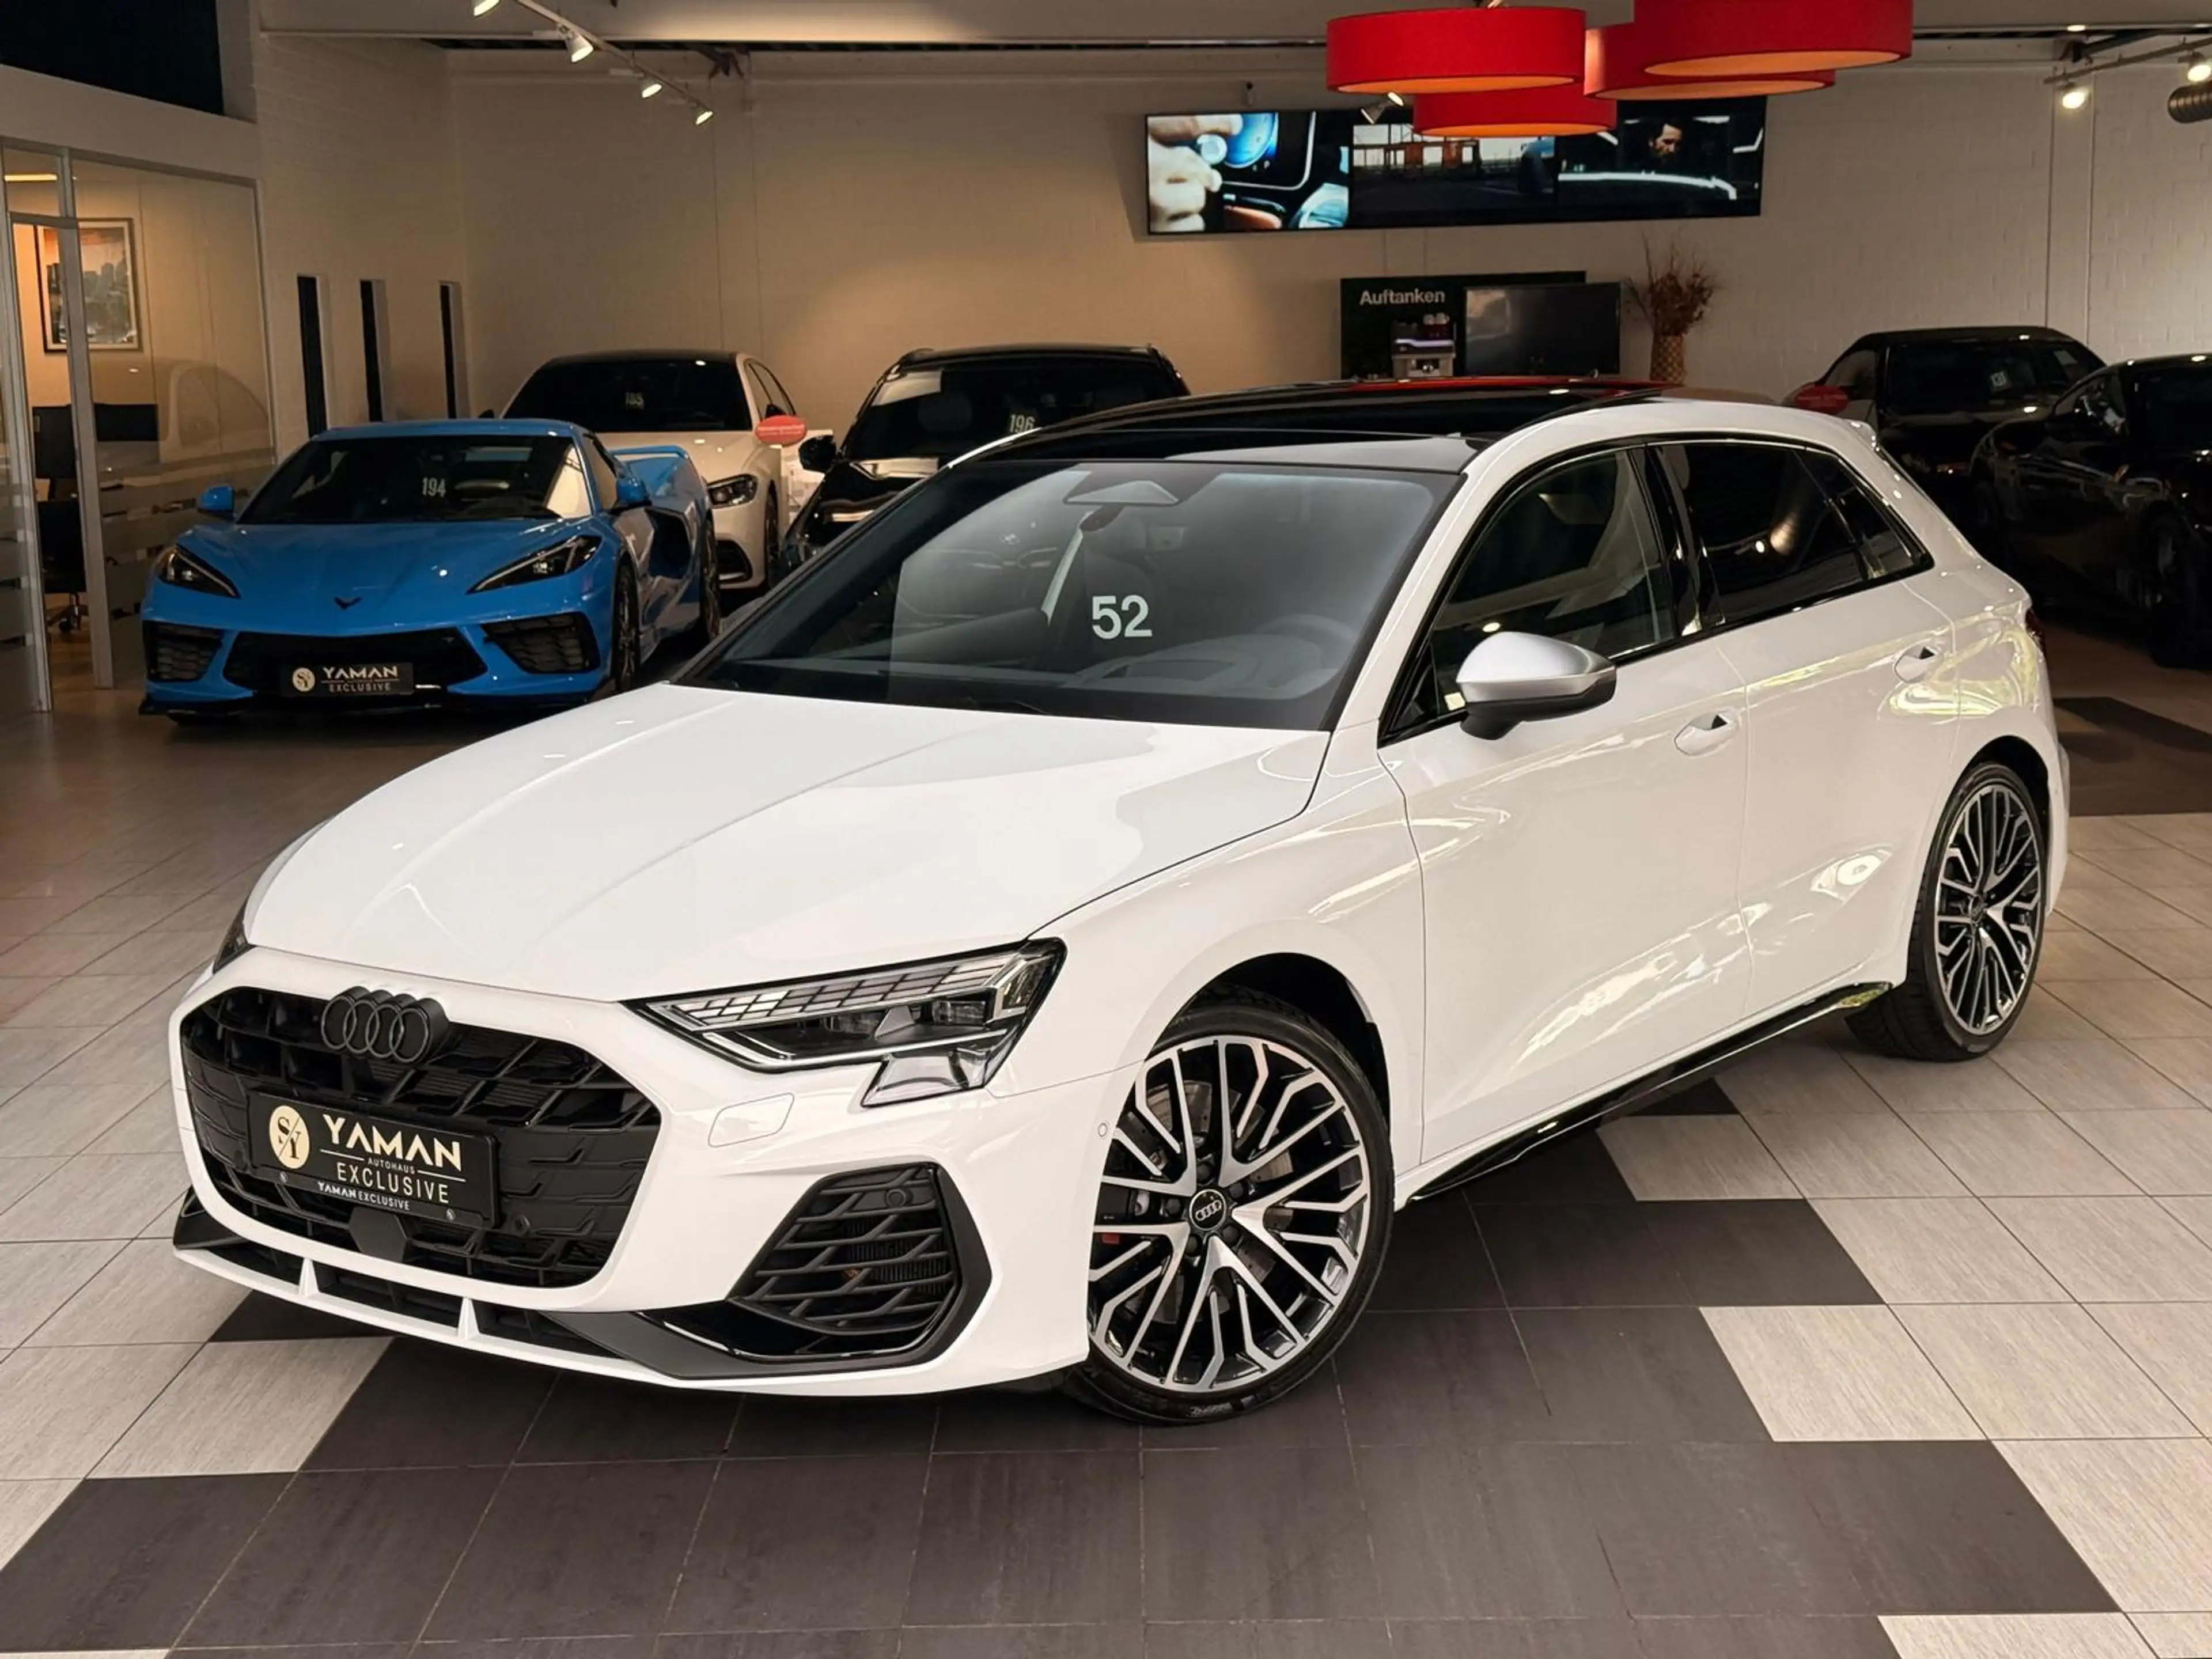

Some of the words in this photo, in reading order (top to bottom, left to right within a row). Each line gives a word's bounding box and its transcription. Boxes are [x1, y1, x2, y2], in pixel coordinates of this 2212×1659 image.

[1360, 288, 1445, 305] Auftanken
[1010, 414, 1036, 433] 196
[422, 477, 446, 498] 194
[1092, 594, 1153, 639] 52
[323, 665, 398, 679] YAMAN
[329, 683, 391, 693] EXCLUSIVE
[323, 1113, 462, 1172] YAMAN
[368, 1157, 415, 1175] AUTOHAUS
[336, 1162, 449, 1204] EXCLUSIVE
[317, 1181, 357, 1199] YAMAN
[358, 1191, 411, 1211] EXCLUSIVE
